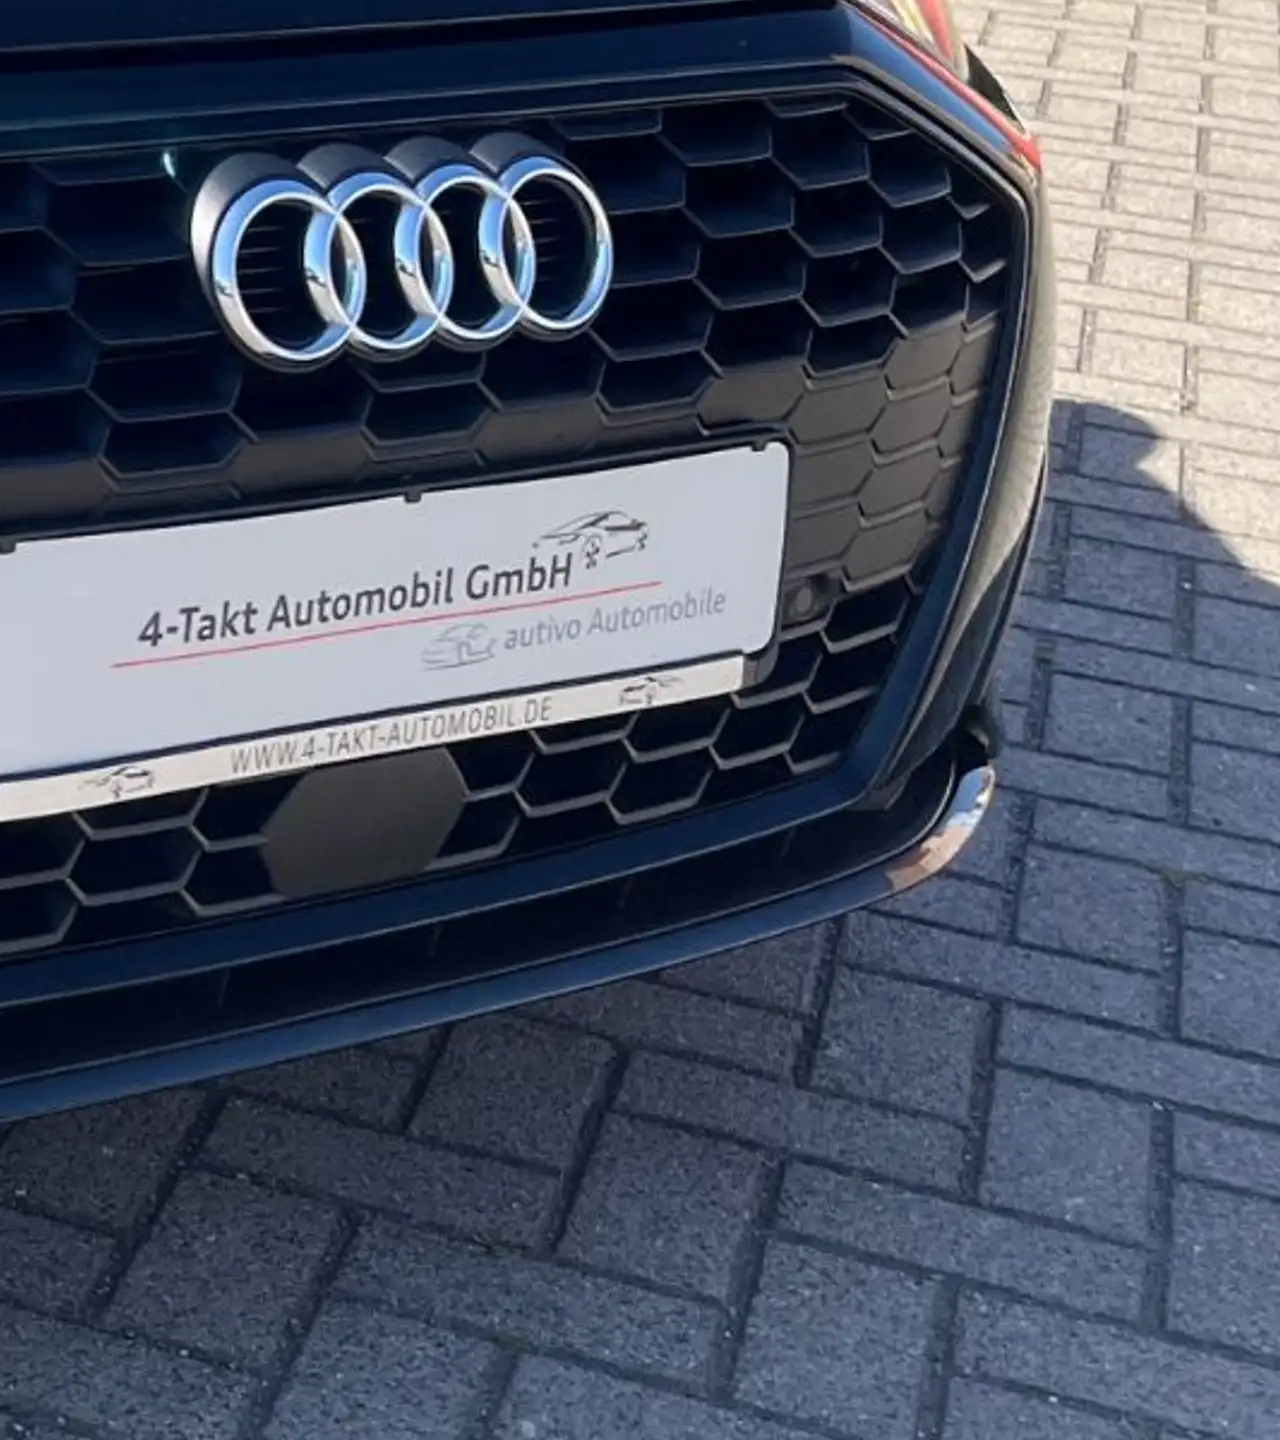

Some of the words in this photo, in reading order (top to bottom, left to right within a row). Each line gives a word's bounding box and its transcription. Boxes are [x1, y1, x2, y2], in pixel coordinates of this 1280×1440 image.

[137, 601, 258, 648] 4-Takt
[267, 566, 455, 633] Automobil
[465, 551, 574, 602] GmbH
[502, 615, 581, 650] autivo
[587, 585, 727, 634] Automobile
[230, 695, 554, 775] WWW.4-TAKT-AUTOMOBIL.DE
